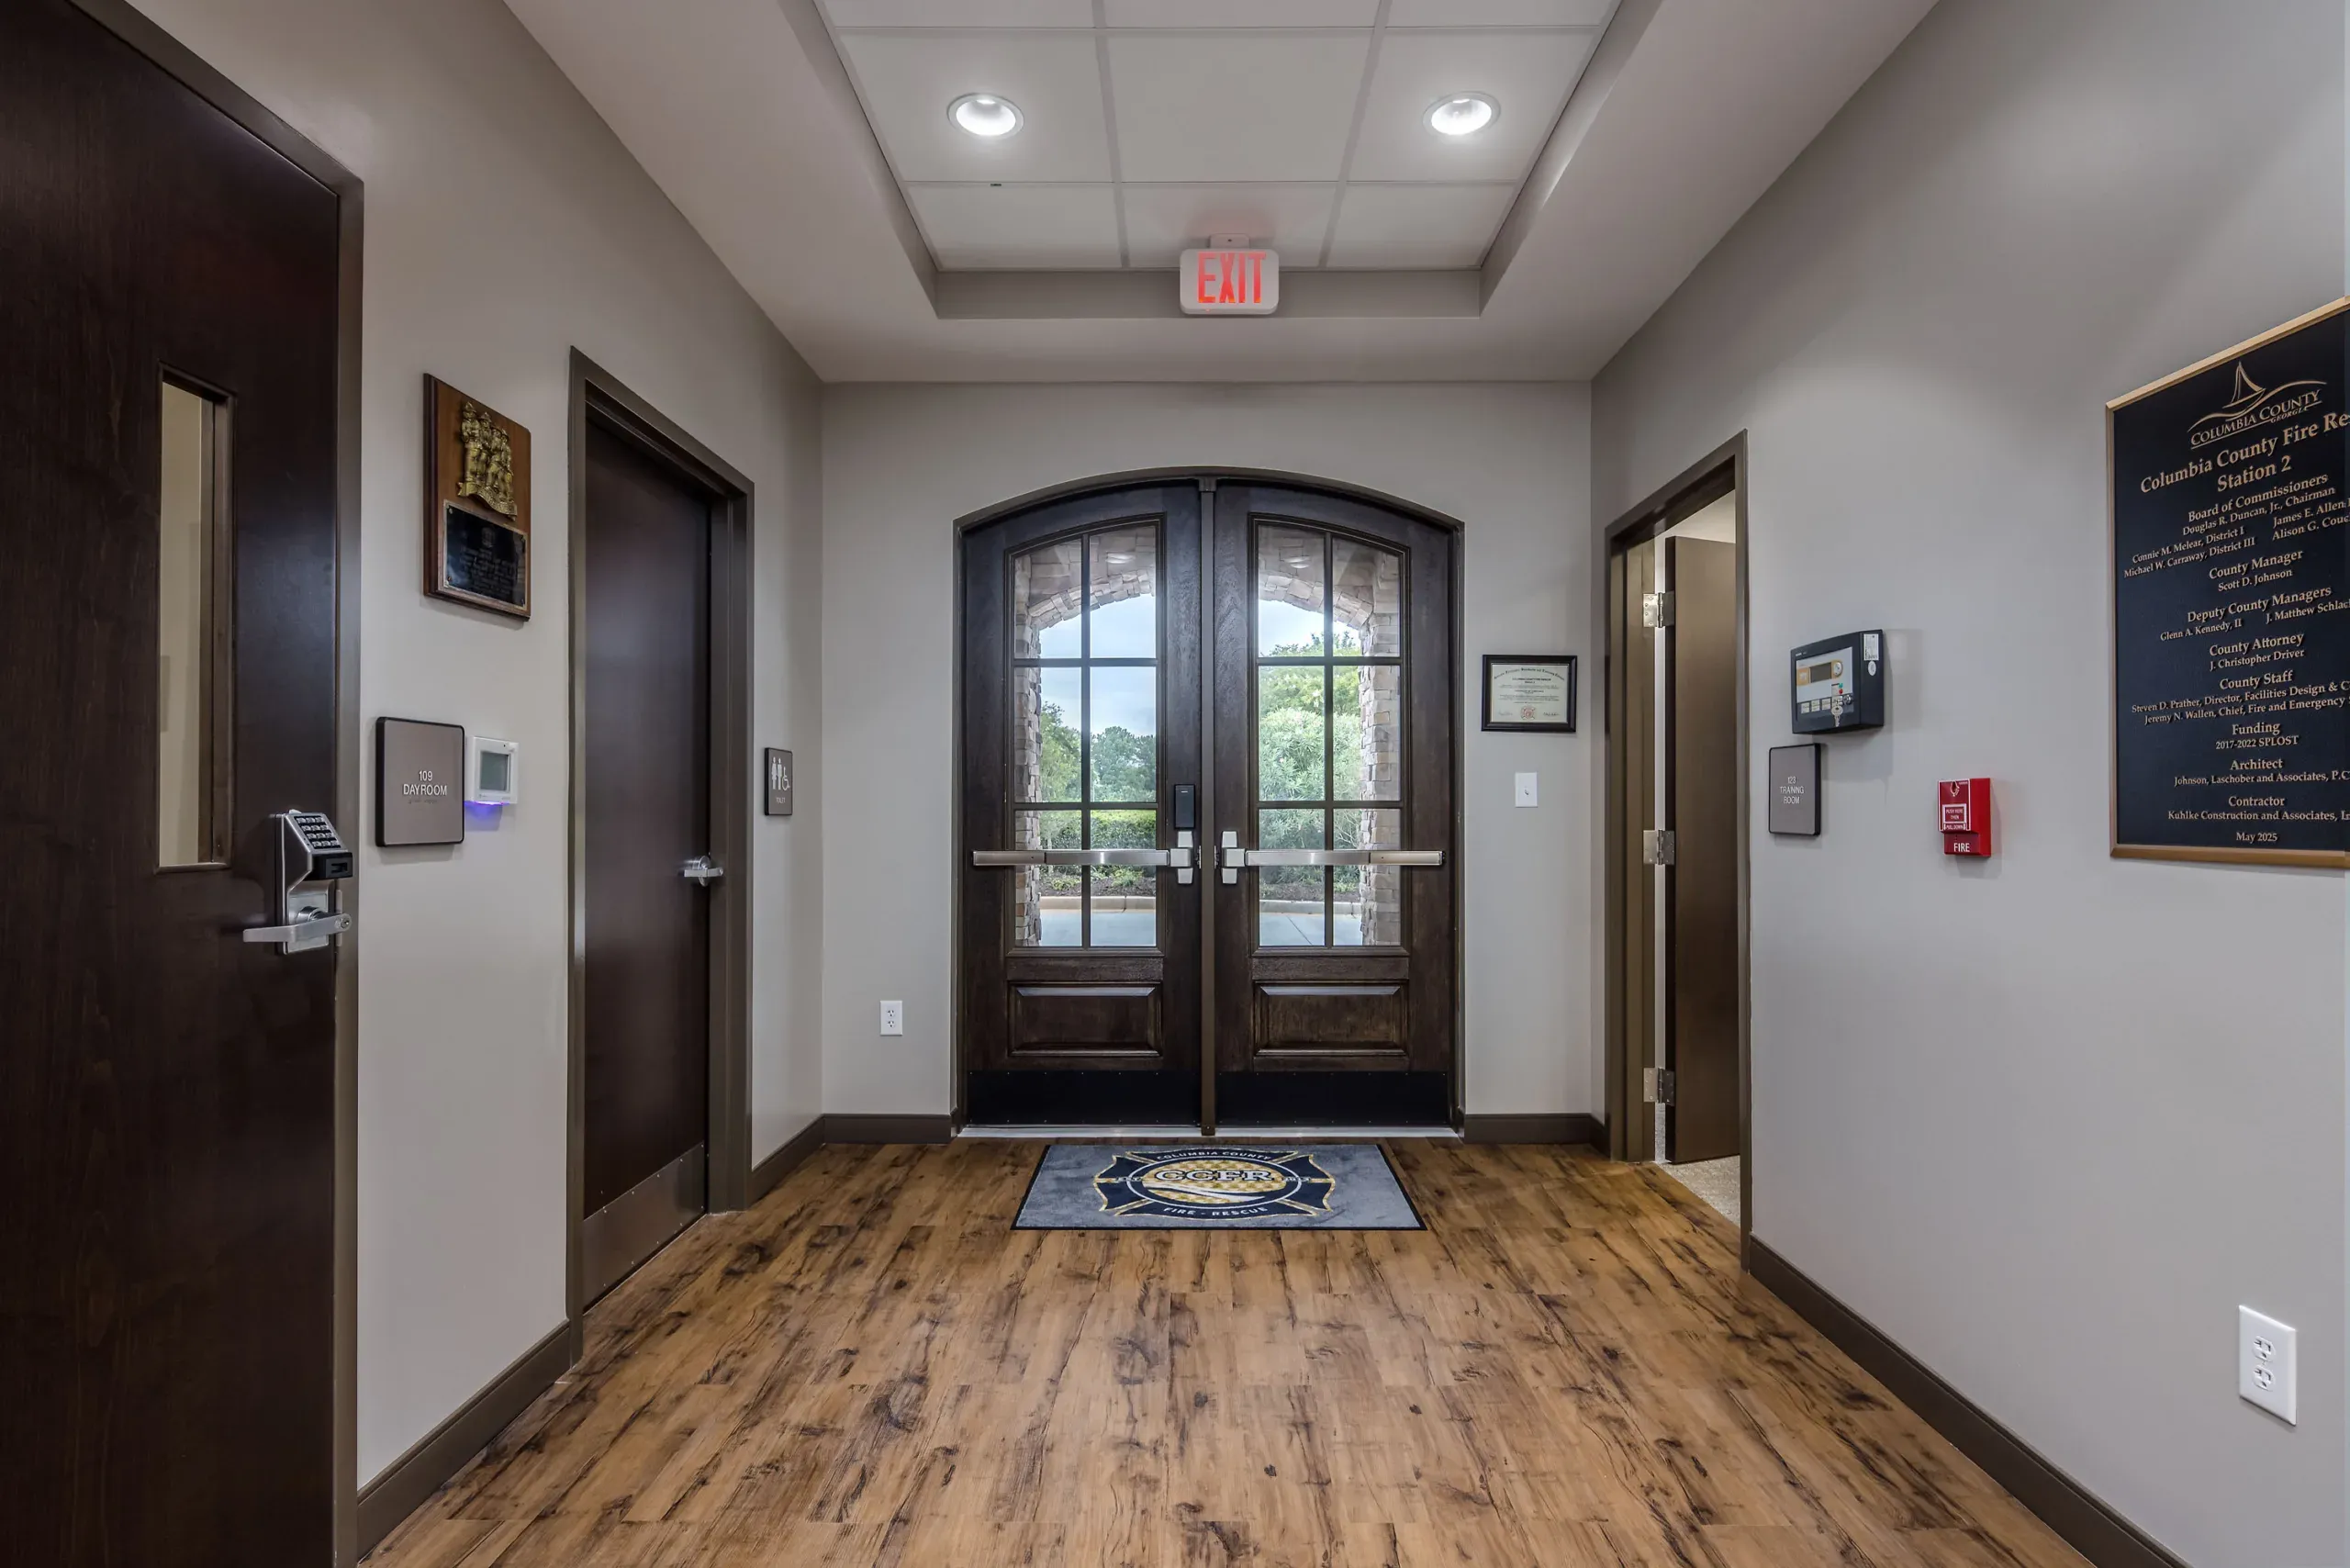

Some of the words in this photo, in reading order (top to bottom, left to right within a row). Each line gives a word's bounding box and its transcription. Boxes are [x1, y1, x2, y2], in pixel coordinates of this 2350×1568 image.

[1197, 251, 1266, 303] EXIT
[2190, 414, 2256, 445] COLUMBIA
[2259, 388, 2322, 420] COUNTY
[2141, 459, 2212, 493] Columbia
[2217, 436, 2278, 467] County
[2282, 423, 2319, 446] Fire
[2323, 412, 2350, 432] Re
[2217, 464, 2277, 492] Station
[2280, 455, 2292, 472] 2
[2188, 503, 2219, 522] Board
[2221, 498, 2233, 512] of
[2235, 474, 2329, 509] Commissioners
[2183, 520, 2217, 536] Douglas
[2219, 516, 2228, 525] R.
[2230, 507, 2267, 522] Duncan,
[2285, 487, 2335, 507] Chairman
[2273, 511, 2302, 529] James
[2304, 508, 2313, 518] E.
[2272, 525, 2305, 541] Alison
[2307, 521, 2320, 532] G.
[2322, 514, 2350, 528] Couc
[2132, 550, 2160, 564] Connie
[2173, 540, 2204, 553] Melear,
[2206, 528, 2238, 544] District
[2240, 525, 2245, 535] I
[2124, 563, 2154, 578] Michael
[2155, 560, 2165, 570] W.
[2167, 551, 2208, 567] Carraway,
[2209, 542, 2241, 557] District
[2244, 536, 2256, 548] III
[2209, 564, 2248, 579] County
[2251, 550, 2303, 569] Manager
[2218, 580, 2240, 592] Scott
[2242, 577, 2252, 587] D.
[2254, 569, 2293, 587] Johnson
[2188, 607, 2225, 623] Deputy
[2228, 598, 2269, 614] County
[2272, 587, 2332, 606] Managers
[2266, 613, 2273, 624] J.
[2275, 607, 2314, 621] Matthew
[2160, 630, 2183, 642] Glenn
[2185, 628, 2193, 636] A.
[2195, 621, 2232, 635] Kennedy,
[2234, 618, 2243, 628] II
[2210, 642, 2249, 656] County
[2252, 633, 2304, 650] Attorney
[2210, 661, 2216, 671] J.
[2218, 654, 2271, 668] Christopher
[2273, 648, 2305, 661] Driver
[2220, 677, 2260, 690] County
[2263, 669, 2294, 685] Staff
[2132, 702, 2157, 713] Steven
[2159, 700, 2169, 710] D.
[2170, 699, 2202, 710] Prather,
[2204, 694, 2243, 706] Director,
[2244, 689, 2287, 701] Facilities
[2289, 683, 2325, 697] Design
[2328, 681, 2339, 692] &
[2341, 680, 2350, 690] C
[2144, 714, 2171, 726] Jeremy
[2173, 711, 2183, 721] N.
[2186, 708, 2217, 720] Wallen,
[2219, 705, 2245, 717] Chief,
[2248, 703, 2266, 713] Fire
[2268, 700, 2287, 711] and
[2288, 697, 2345, 711] Emergency
[2232, 722, 2281, 735] Funding
[2215, 738, 2256, 750] 2017-2022
[2258, 735, 2300, 747] SPLOST
[418, 770, 433, 781] 109
[2230, 758, 2283, 770] Architect
[403, 783, 447, 796] DAYROOM
[2174, 776, 2210, 788] Johnson,
[2210, 773, 2257, 785] Laschober
[2256, 773, 2274, 783] and
[2276, 771, 2329, 782] Associates,
[2332, 769, 2350, 780] P.C
[2228, 796, 2285, 807] Contractor
[2168, 810, 2199, 820] Kuhlke
[2200, 810, 2259, 820] Construction
[2260, 811, 2279, 820] and
[2281, 810, 2338, 822] Associates,
[1953, 843, 1970, 852] FIRE
[2236, 832, 2255, 844] May
[2257, 832, 2278, 843] 2025
[1157, 1151, 1218, 1160] COLUMBIA
[1222, 1150, 1271, 1159] COUNTY
[1155, 1170, 1275, 1182] CCFR
[1163, 1207, 1196, 1215] FIRE
[1212, 1206, 1268, 1216] RESCUE
